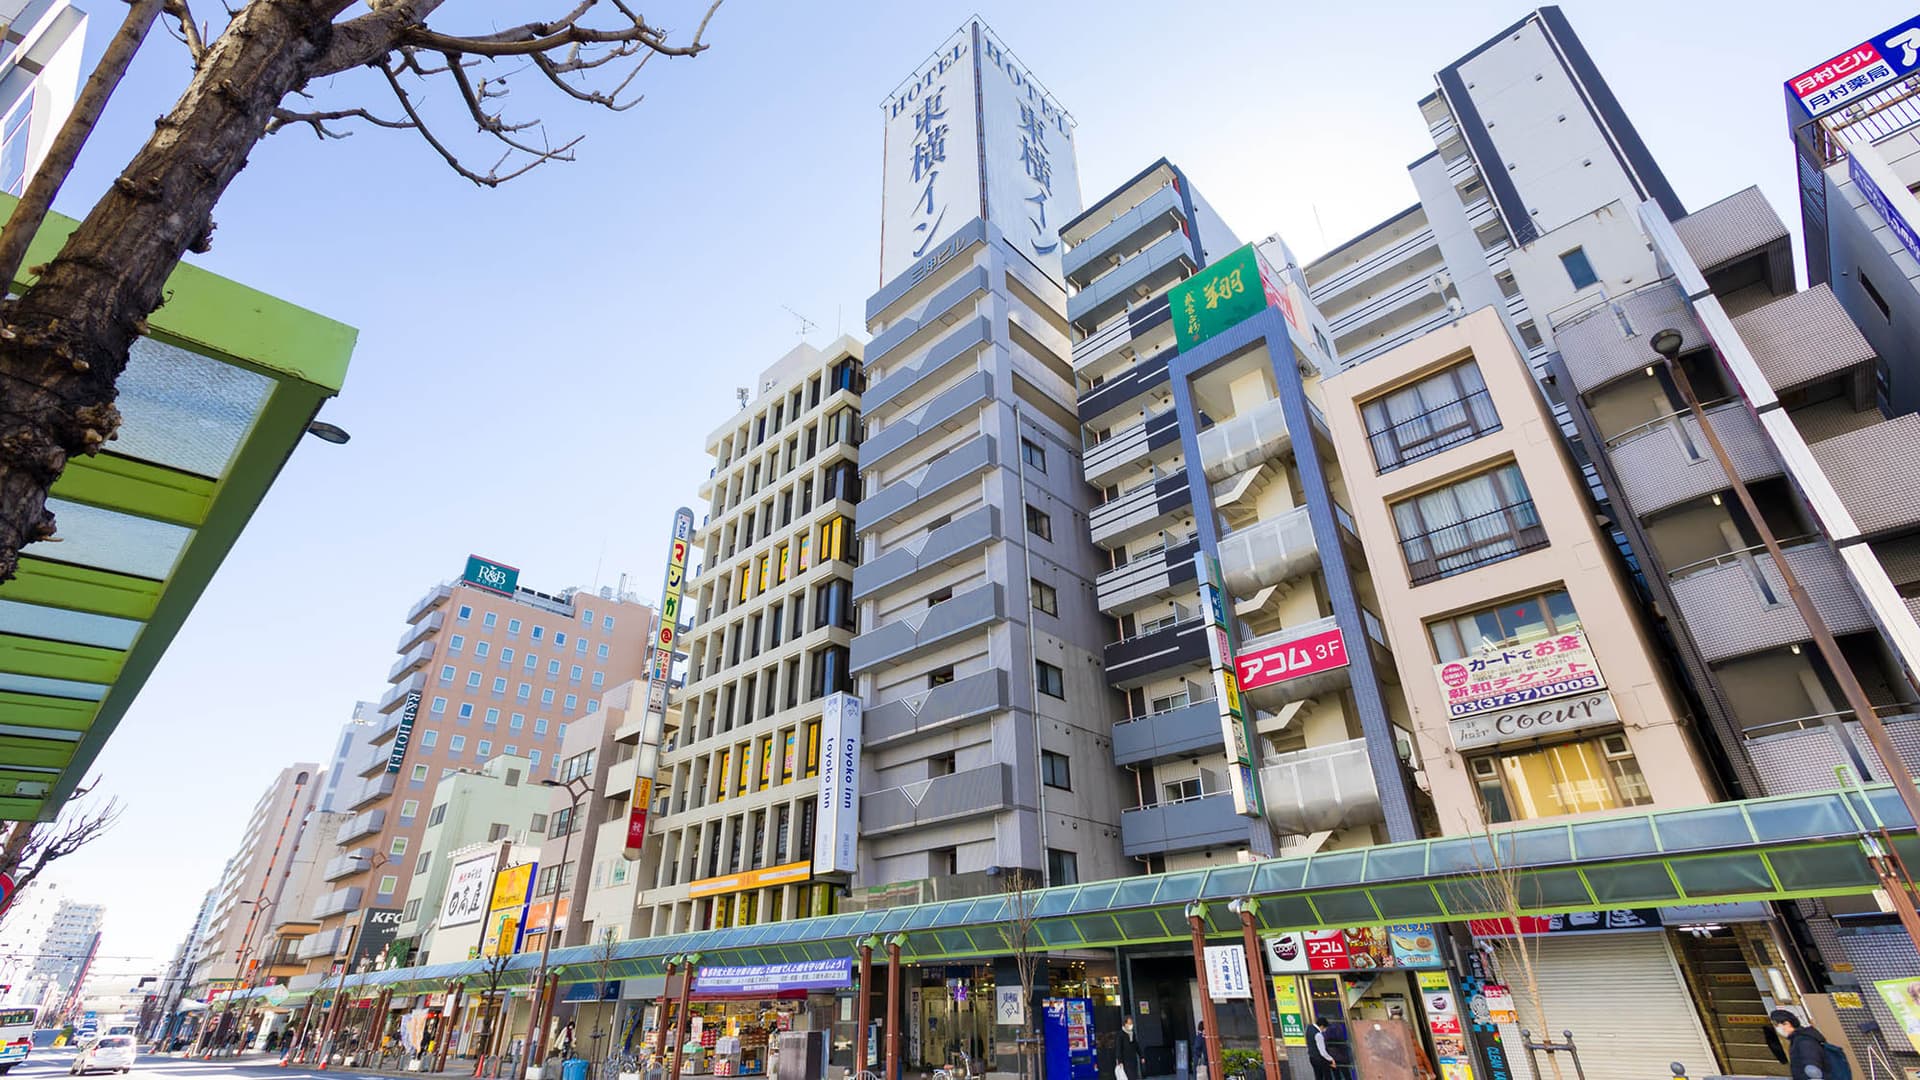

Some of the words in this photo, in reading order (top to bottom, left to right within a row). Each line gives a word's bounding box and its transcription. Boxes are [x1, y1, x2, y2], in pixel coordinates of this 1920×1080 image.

[891, 42, 968, 122] HOTEL
[984, 37, 1070, 141] HOTEL
[1795, 50, 1873, 94] 月村ビル
[1809, 65, 1889, 110] 月村薬局
[909, 85, 950, 258] 東横イン
[1016, 96, 1058, 255] 東横イン
[479, 565, 507, 585] R&B
[1240, 647, 1312, 684] アコム
[1315, 640, 1340, 660] 3F
[1469, 635, 1581, 673] カードでお金
[1448, 662, 1588, 699] 新和チケット
[1452, 676, 1598, 714] 03(3737)0008
[403, 692, 421, 721] R&B
[388, 723, 412, 773] HOTEL
[824, 737, 834, 784] toyoko
[845, 738, 855, 784] toyoko
[824, 787, 832, 809] inn
[844, 787, 852, 809] inn
[371, 911, 403, 925] KFC
[1309, 941, 1343, 954] アコム
[1322, 958, 1337, 968] 3F
